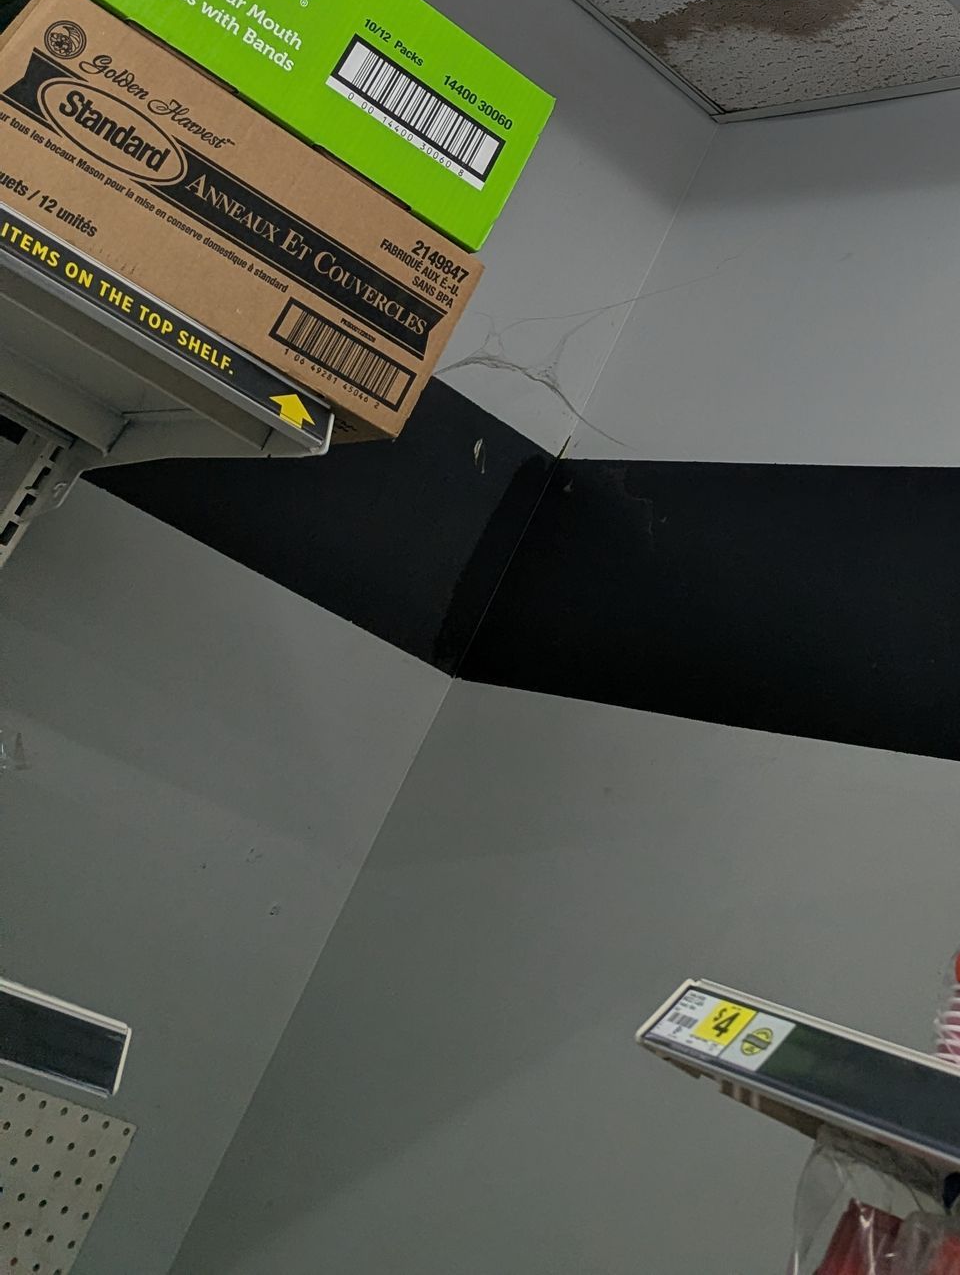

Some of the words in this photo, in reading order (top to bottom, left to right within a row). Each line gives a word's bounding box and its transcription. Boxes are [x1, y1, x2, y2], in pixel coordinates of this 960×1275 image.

[201, 0, 241, 37] with
[242, 27, 295, 72] Bands
[246, 3, 303, 51] Mouth
[363, 18, 392, 43] 10/12
[394, 40, 424, 67] Packs
[58, 90, 172, 172] Standard
[79, 54, 150, 101] Golden
[147, 98, 228, 150] Harvest
[443, 75, 478, 106] 14400
[477, 100, 513, 130] 30060
[347, 92, 355, 101] 0
[361, 101, 375, 115] 00
[382, 116, 414, 143] 14400
[420, 143, 451, 168] 30060
[457, 169, 465, 177] 8
[0, 112, 10, 122] ur
[10, 116, 30, 135] tous
[30, 129, 44, 144] les
[44, 137, 76, 165] bocaux
[76, 158, 105, 180] Mason
[103, 176, 126, 196] pour
[125, 186, 135, 198] la
[134, 193, 156, 212] mise
[155, 205, 167, 219] en
[166, 211, 203, 241] conserve
[203, 237, 248, 269] domestique
[253, 267, 289, 293] standard
[0, 171, 29, 196] uets
[38, 194, 59, 214] 12
[56, 207, 98, 238] unités
[379, 238, 424, 273] FABRIQUÉ
[418, 267, 440, 283] AUX
[411, 240, 470, 284] 2149847
[412, 276, 437, 298] SANS
[436, 292, 455, 309] BPA
[0, 222, 60, 268] ITEMS
[65, 262, 94, 288] ON
[99, 280, 134, 313] THE
[139, 305, 174, 335] TOP
[177, 330, 235, 375] SHELF.
[284, 348, 289, 356] 1
[294, 355, 305, 365] 06
[310, 364, 338, 385] 49281
[342, 383, 369, 404] 45046
[374, 401, 381, 410] 2
